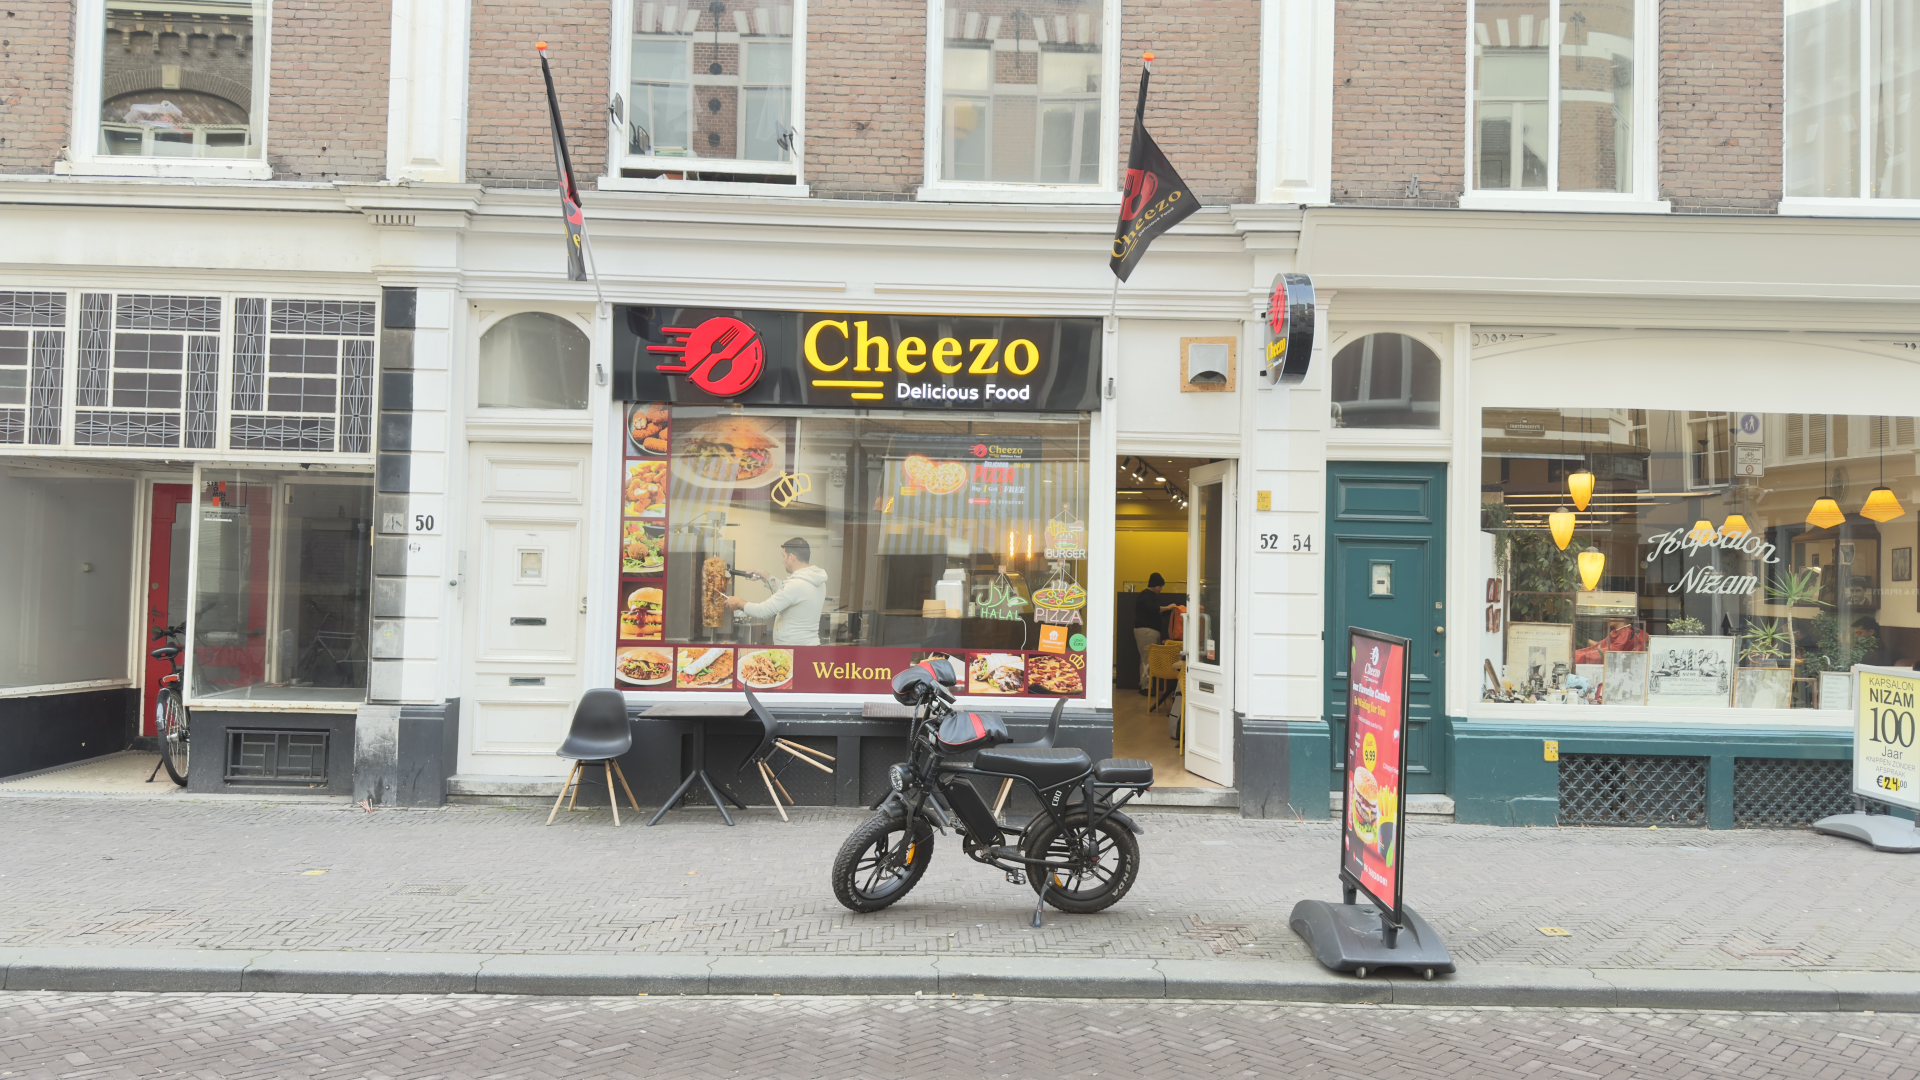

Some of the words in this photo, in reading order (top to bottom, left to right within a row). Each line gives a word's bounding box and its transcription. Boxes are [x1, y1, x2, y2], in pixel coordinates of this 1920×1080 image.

[1112, 190, 1182, 258] Cheezo
[803, 319, 1041, 376] Cheezo
[1266, 337, 1286, 361] Cheezo
[897, 382, 979, 401] Delicious
[985, 383, 1030, 401] Food
[988, 444, 1023, 454] Cheezo
[972, 464, 1016, 483] PIZZA
[1004, 486, 1026, 494] FREE
[415, 514, 434, 531] 50
[1260, 534, 1278, 550] 52
[1292, 534, 1312, 552] 54
[1646, 525, 1780, 564] Kapsalon
[1046, 548, 1086, 559] BURGER
[1667, 565, 1758, 594] Nizam
[978, 581, 1028, 608] حلال
[981, 608, 1022, 620] HALAL
[1035, 608, 1082, 624] PIZZA
[812, 662, 891, 680] Welkom
[1364, 662, 1380, 678] Cheezo
[1869, 677, 1914, 691] KAPSALON
[1375, 689, 1390, 703] Combo
[1870, 688, 1914, 708] NIZAM
[1358, 697, 1370, 714] Waiting
[1377, 705, 1386, 717] You
[1869, 707, 1915, 748] 100
[1881, 746, 1903, 760] Jaar
[1866, 756, 1891, 766] KNIPPEN
[1892, 761, 1916, 772] ZONDER
[1876, 766, 1906, 778] AFSPRAAK
[1112, 854, 1132, 897] KENDA
